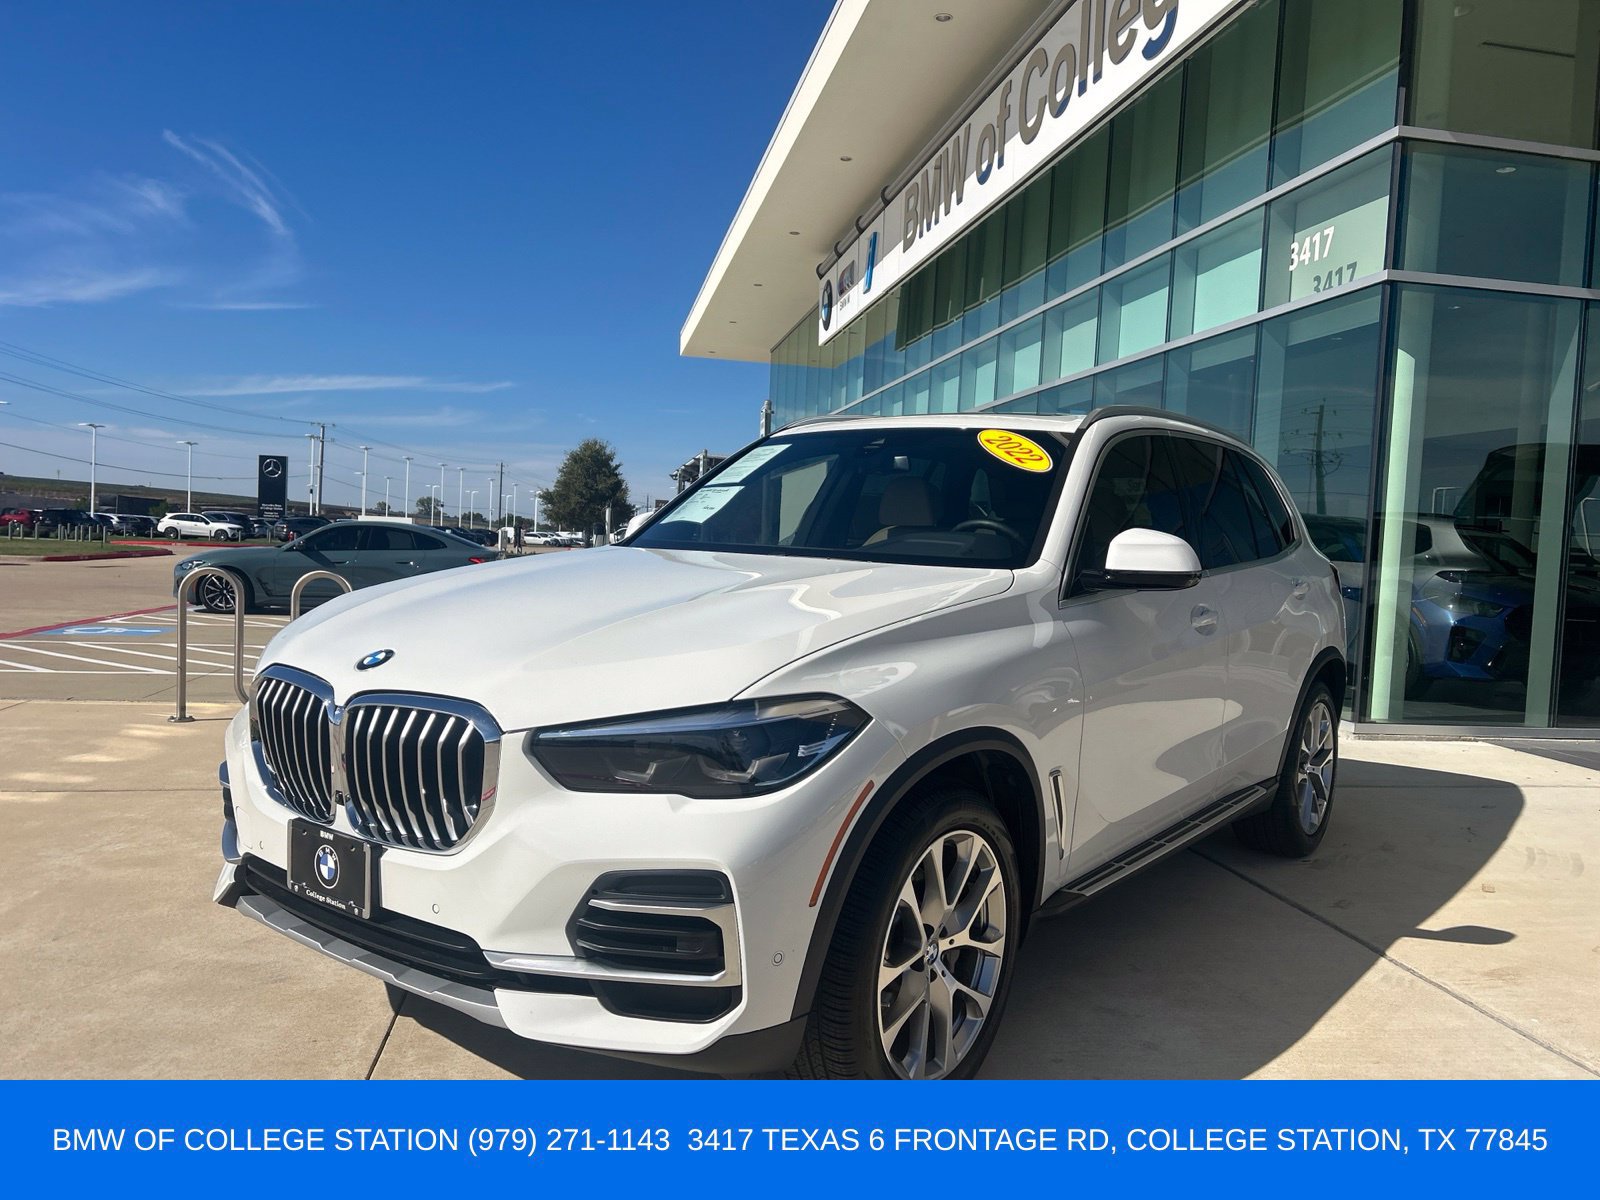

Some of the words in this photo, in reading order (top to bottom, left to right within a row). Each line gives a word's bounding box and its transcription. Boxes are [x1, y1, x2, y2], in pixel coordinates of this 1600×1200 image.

[902, 122, 971, 254] BMW
[975, 79, 1012, 186] of
[1288, 225, 1335, 272] 3417
[984, 435, 1044, 464] 2022
[320, 830, 334, 840] BMW
[306, 889, 326, 902] College
[326, 897, 346, 910] Station
